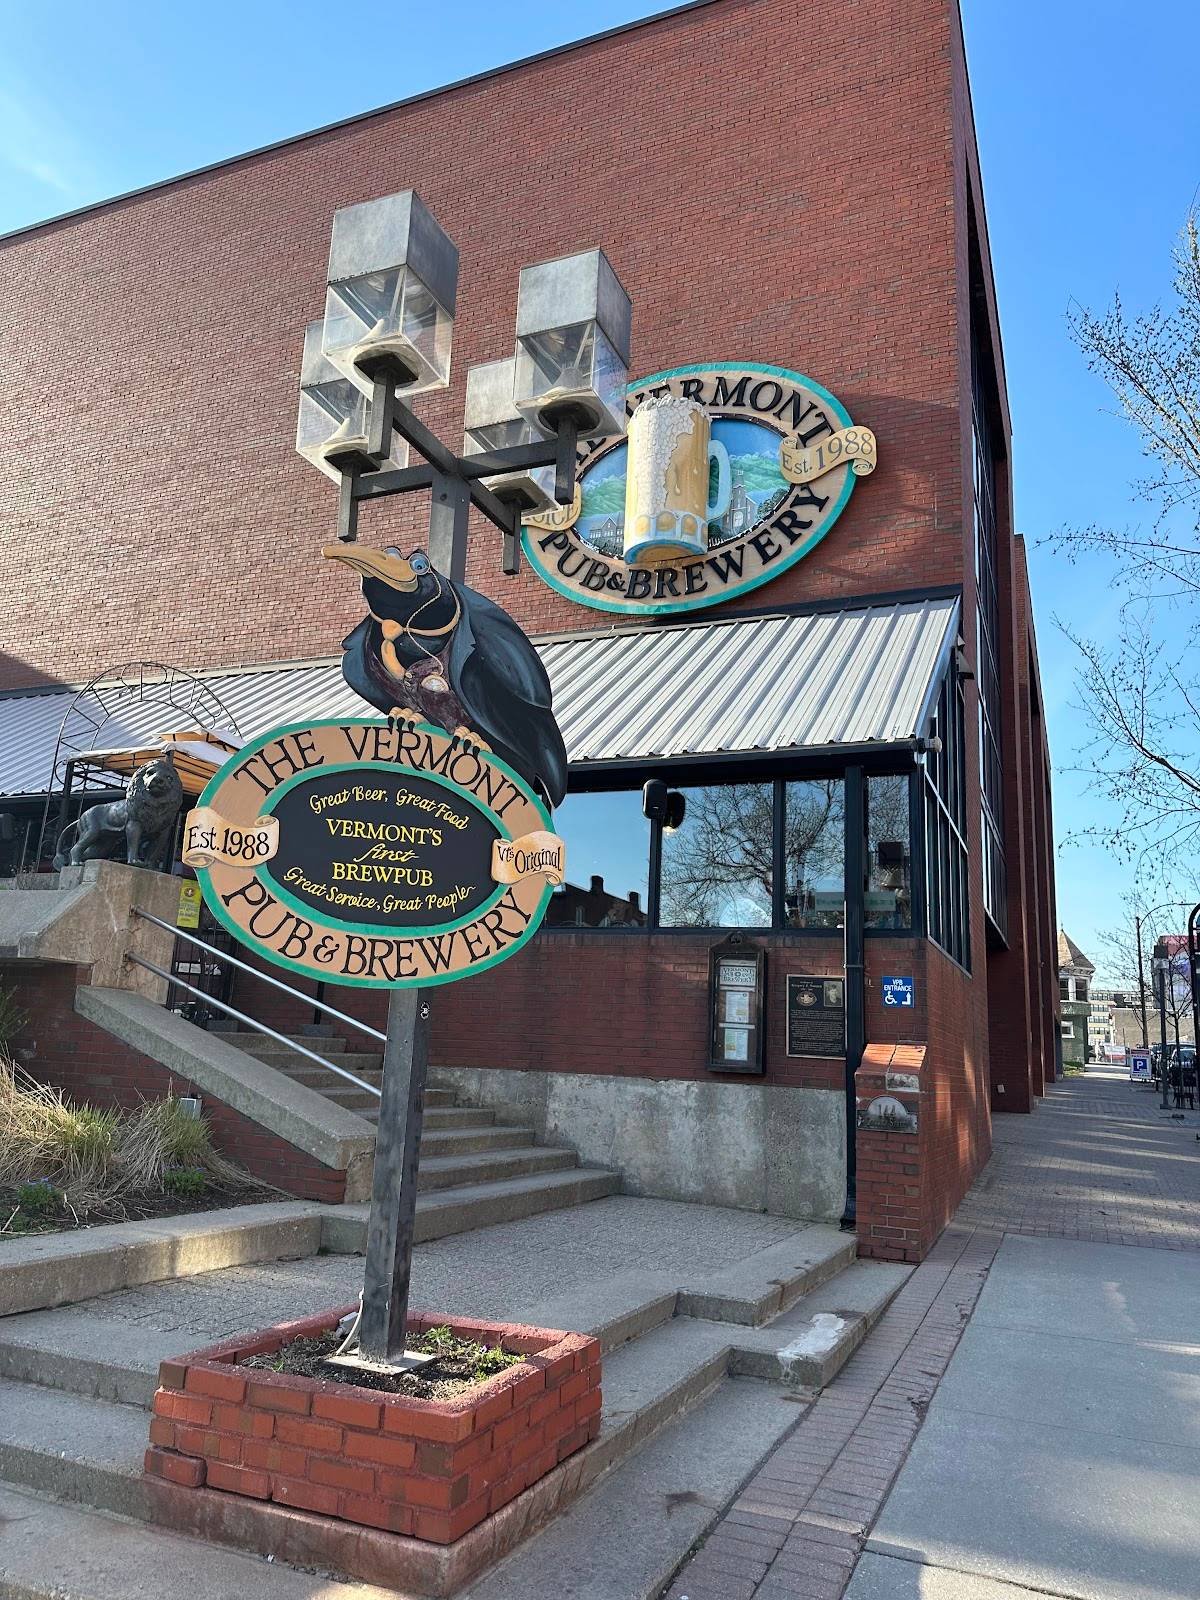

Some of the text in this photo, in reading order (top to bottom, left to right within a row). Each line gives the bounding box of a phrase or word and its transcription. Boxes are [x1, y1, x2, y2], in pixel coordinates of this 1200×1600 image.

[781, 430, 874, 475] Est. 1988
[623, 483, 830, 600] BREWERY
[233, 726, 528, 818] THE VERMONT
[310, 786, 470, 830] Great Beer, Great Food
[186, 825, 270, 860] Est. 1988
[325, 818, 443, 847] VERMONT'S
[353, 843, 420, 863] first
[514, 846, 562, 874] Original
[283, 866, 476, 913] Great Service, Great People
[332, 862, 433, 887] BREWPUB
[222, 876, 309, 960] PUB
[340, 888, 532, 982] BREWERY
[883, 984, 912, 992] ENTRANCE
[892, 978, 904, 986] VPB
